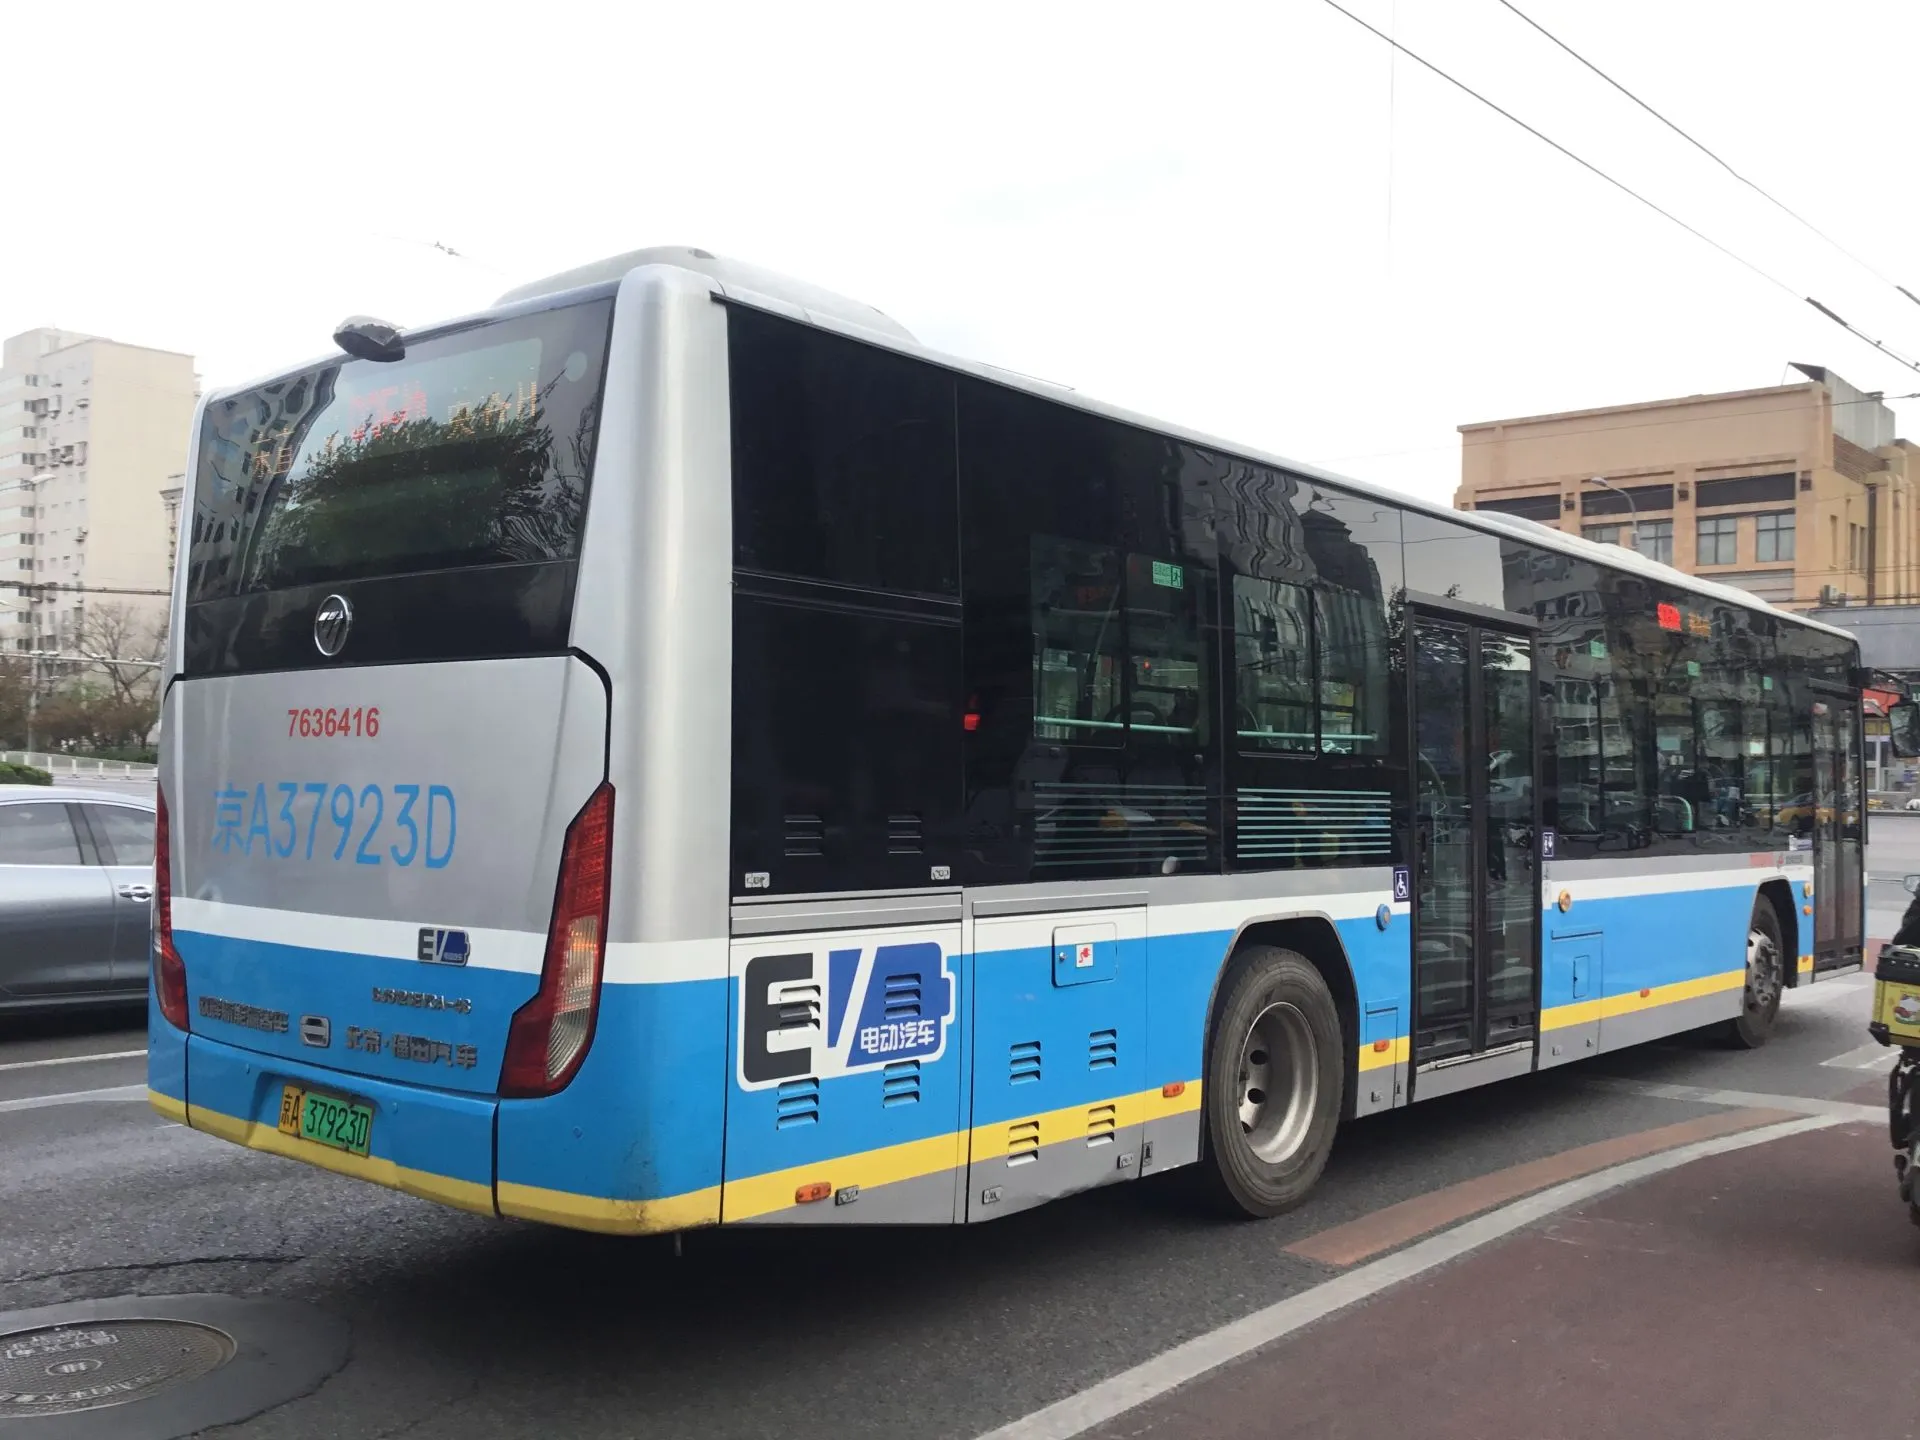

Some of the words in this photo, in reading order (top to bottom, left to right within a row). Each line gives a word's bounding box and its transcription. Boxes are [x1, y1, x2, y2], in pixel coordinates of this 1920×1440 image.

[287, 707, 380, 738] 7636416
[211, 782, 457, 869] 京A37923D
[743, 944, 908, 1084] EV
[860, 1019, 936, 1054] 电动汽车
